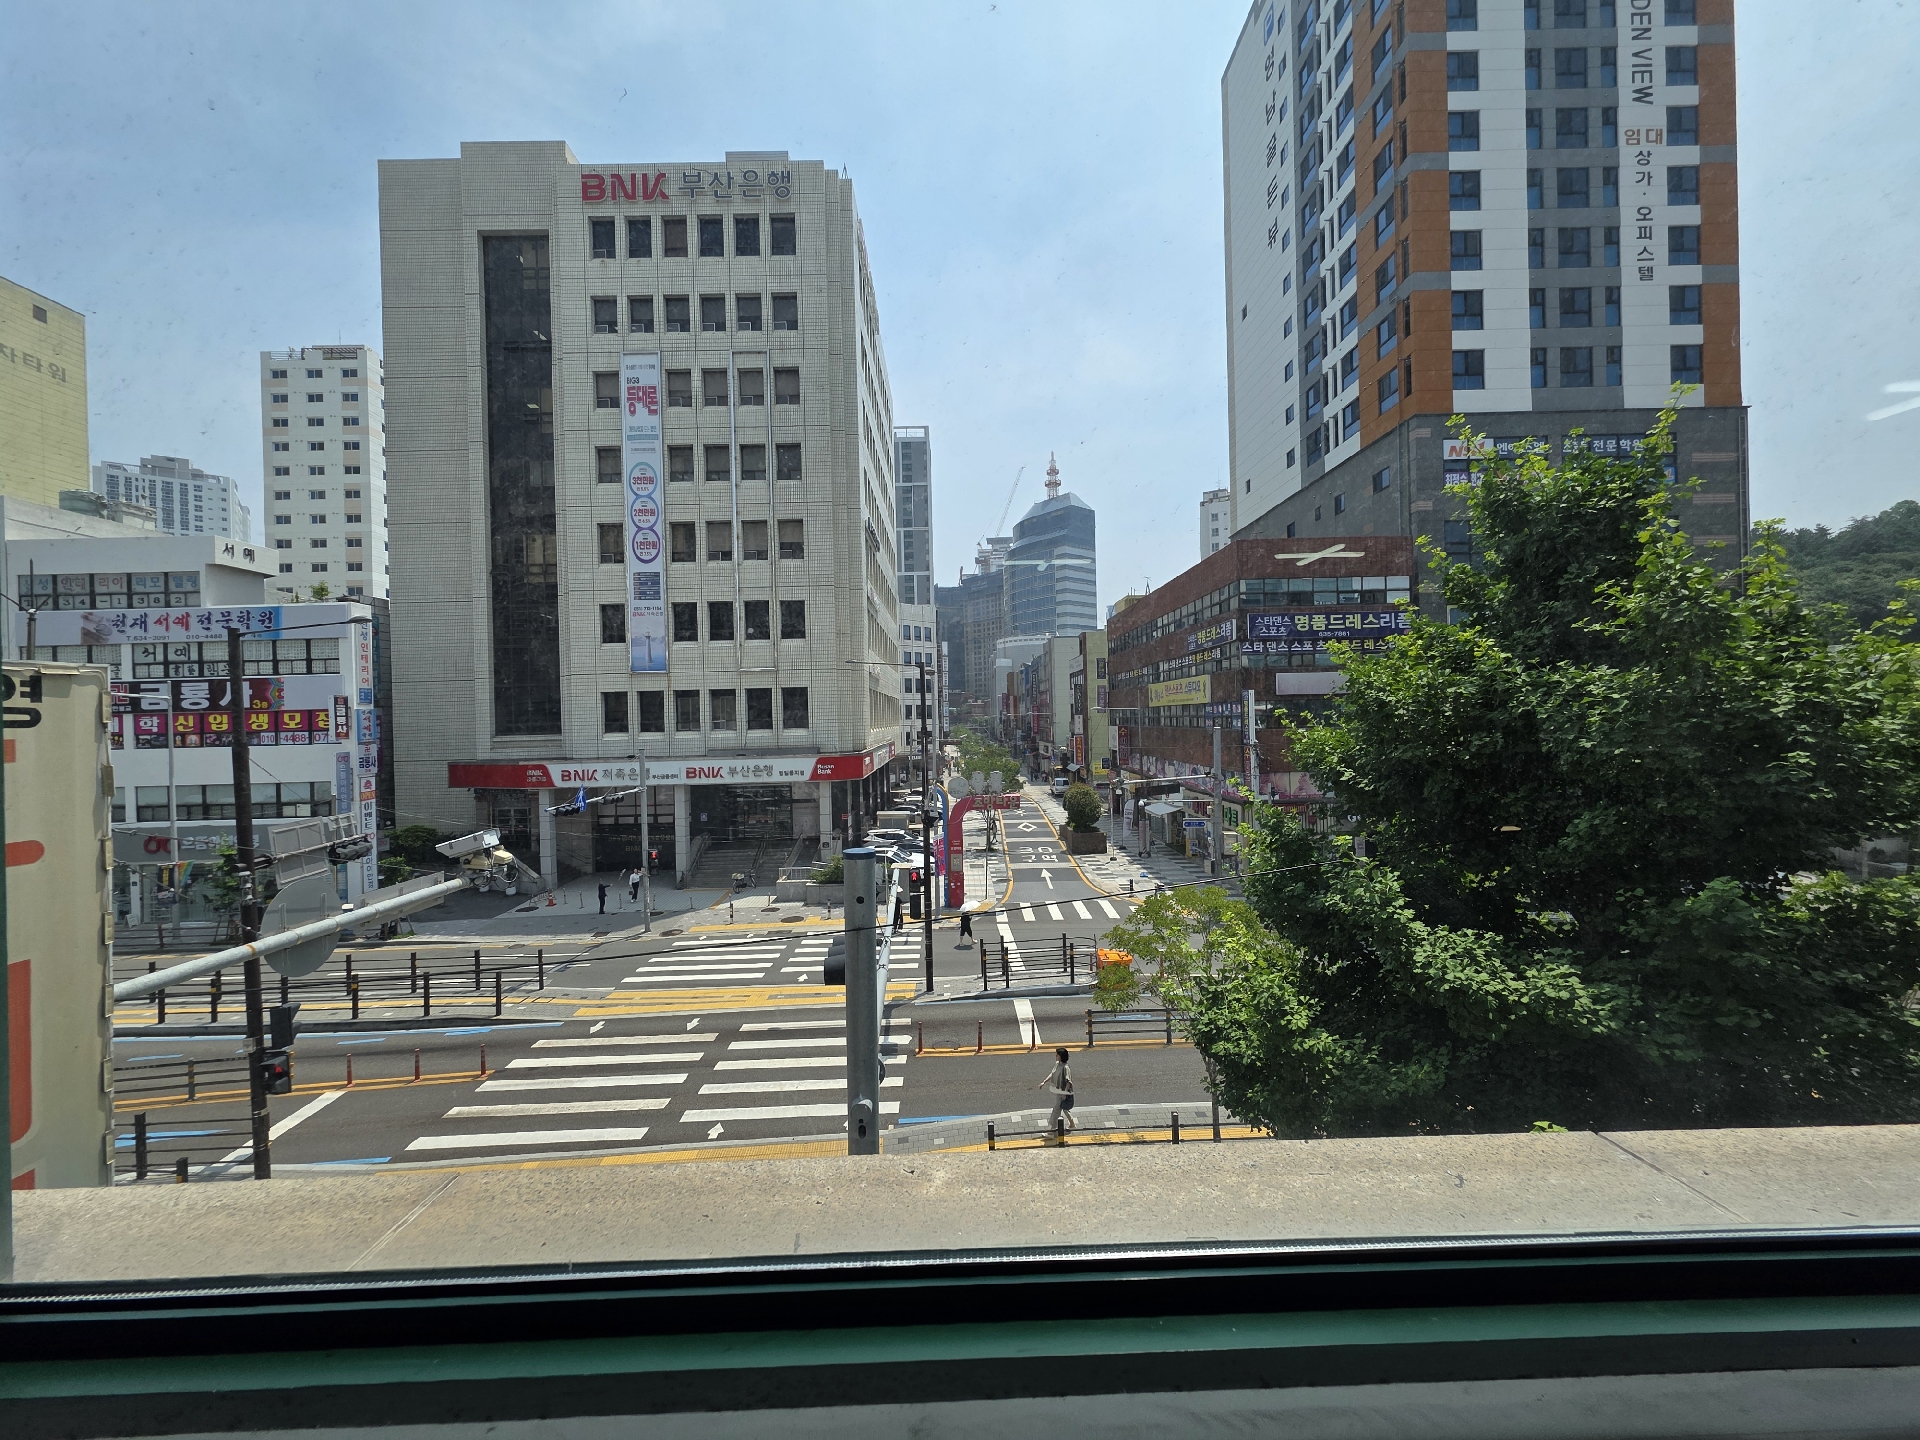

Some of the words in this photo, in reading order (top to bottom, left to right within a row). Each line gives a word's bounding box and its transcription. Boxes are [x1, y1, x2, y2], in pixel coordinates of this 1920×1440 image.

[1631, 48, 1654, 105] VIEW
[1624, 128, 1663, 146] 임대
[581, 172, 670, 201] BNK
[678, 169, 792, 199] 부산은행
[222, 543, 256, 563] 서예
[135, 573, 198, 590] 리모델링
[153, 611, 191, 632] 서예
[196, 610, 274, 631] 전문학원
[1255, 616, 1292, 626] 스타댄스
[1260, 626, 1287, 636] 스포츠
[361, 643, 369, 686] 인테리어
[561, 769, 599, 782] BNK
[686, 767, 724, 779] BNK
[727, 765, 774, 777] 부산은행
[361, 791, 376, 800] OPEN
[364, 802, 373, 831] 이벤트
